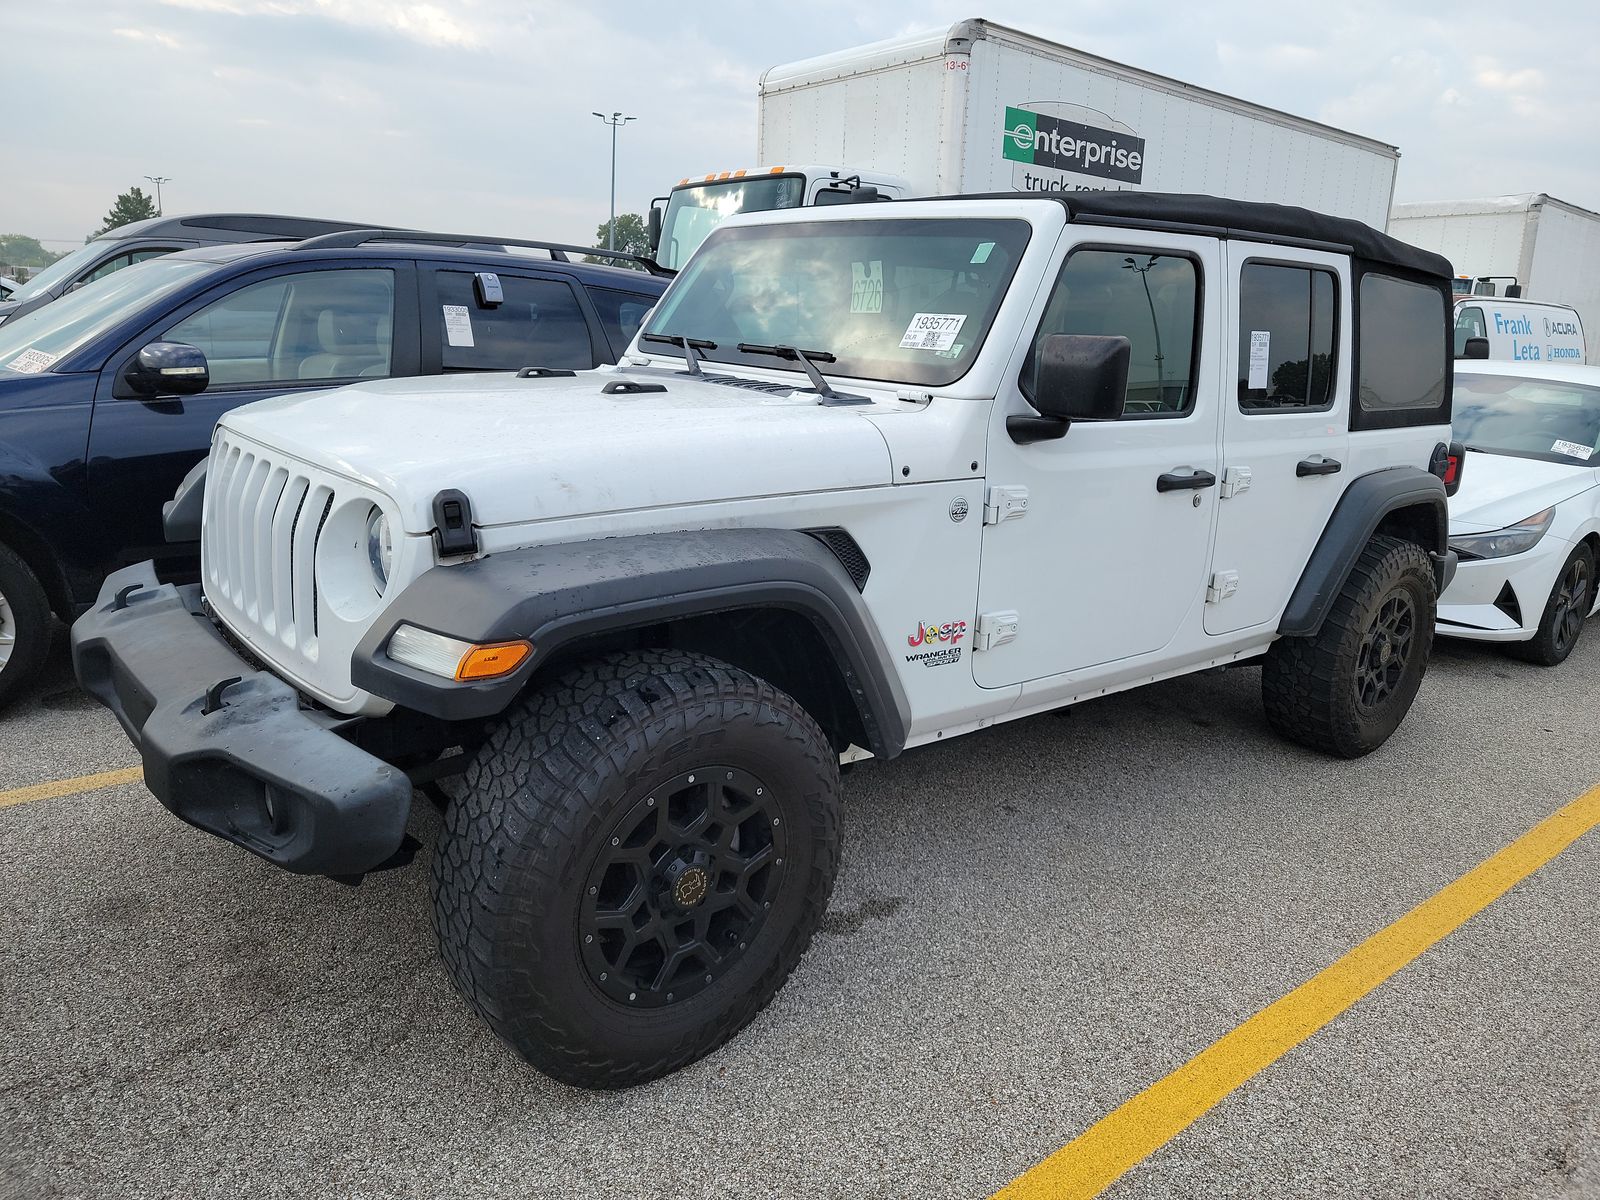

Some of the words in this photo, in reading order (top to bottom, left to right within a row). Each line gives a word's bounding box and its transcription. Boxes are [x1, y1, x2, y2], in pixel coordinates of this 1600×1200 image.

[1012, 123, 1142, 171] enterprise
[1024, 172, 1070, 192] truck
[852, 278, 882, 312] 6726
[914, 316, 961, 331] 1935771
[1493, 312, 1533, 335] Frank
[1552, 321, 1578, 336] ACURA
[1513, 339, 1541, 361] Leta
[1553, 347, 1580, 359] HONDA
[907, 619, 967, 647] Jeep
[905, 647, 961, 662] WRANGLER
